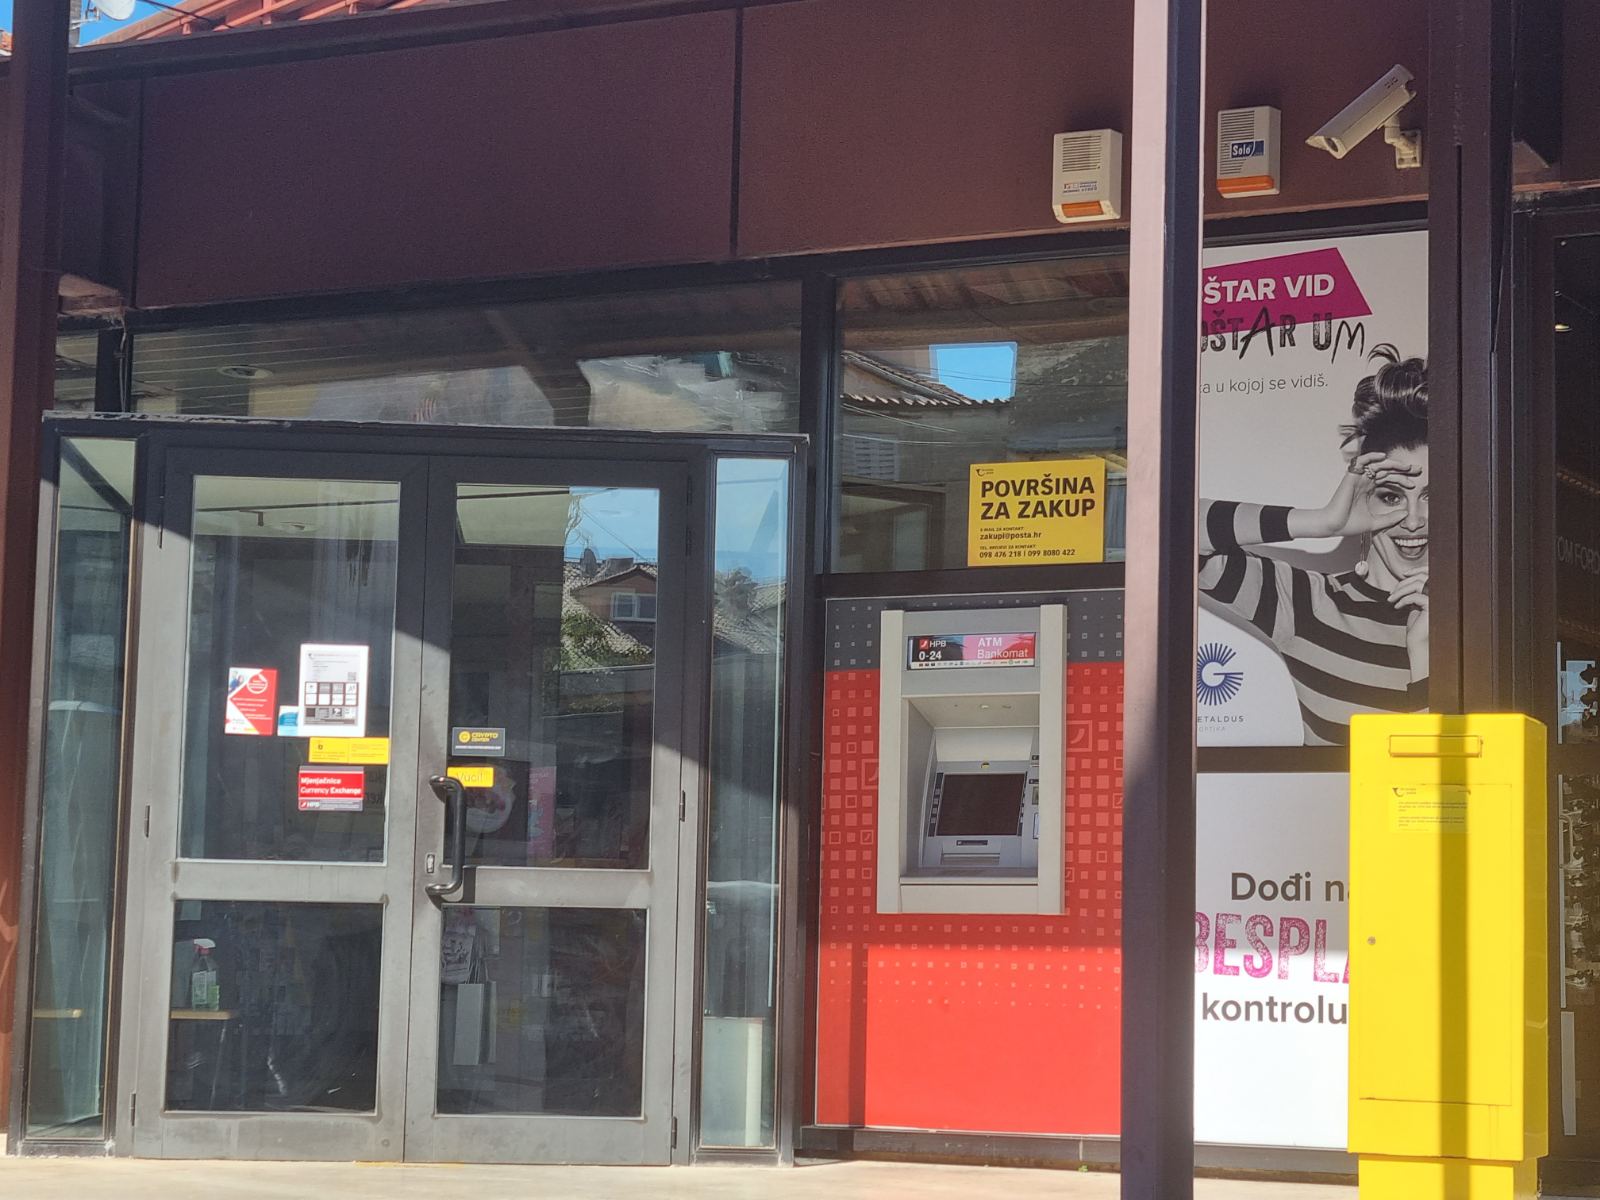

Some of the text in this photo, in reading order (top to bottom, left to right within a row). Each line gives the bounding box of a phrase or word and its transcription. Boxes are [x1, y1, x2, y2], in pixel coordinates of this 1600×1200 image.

[1232, 143, 1251, 156] Solo
[1283, 273, 1335, 298] VID
[1312, 312, 1366, 365] UM
[1216, 381, 1224, 393] u
[1229, 376, 1264, 398] kojoj
[1269, 379, 1286, 391] se
[1291, 373, 1329, 389] vidiš.
[980, 473, 1095, 498] POVRŠINA
[980, 498, 1096, 521] ZA ZAKUP
[979, 531, 1042, 541] zakupi@posta.hr
[979, 551, 992, 559] 098
[1008, 550, 1022, 558] 218
[1027, 549, 1041, 557] 099
[1043, 549, 1060, 557] 8080
[1062, 548, 1076, 556] 422
[929, 639, 947, 648] HPB
[977, 636, 1002, 648] ATM
[918, 650, 942, 661] 0-24
[977, 648, 1029, 660] Bankomat
[300, 786, 362, 795] Currency Exchange
[1231, 871, 1349, 902] Dođi n
[1194, 911, 1350, 984] BESPL
[1202, 992, 1348, 1025] kontrolu
